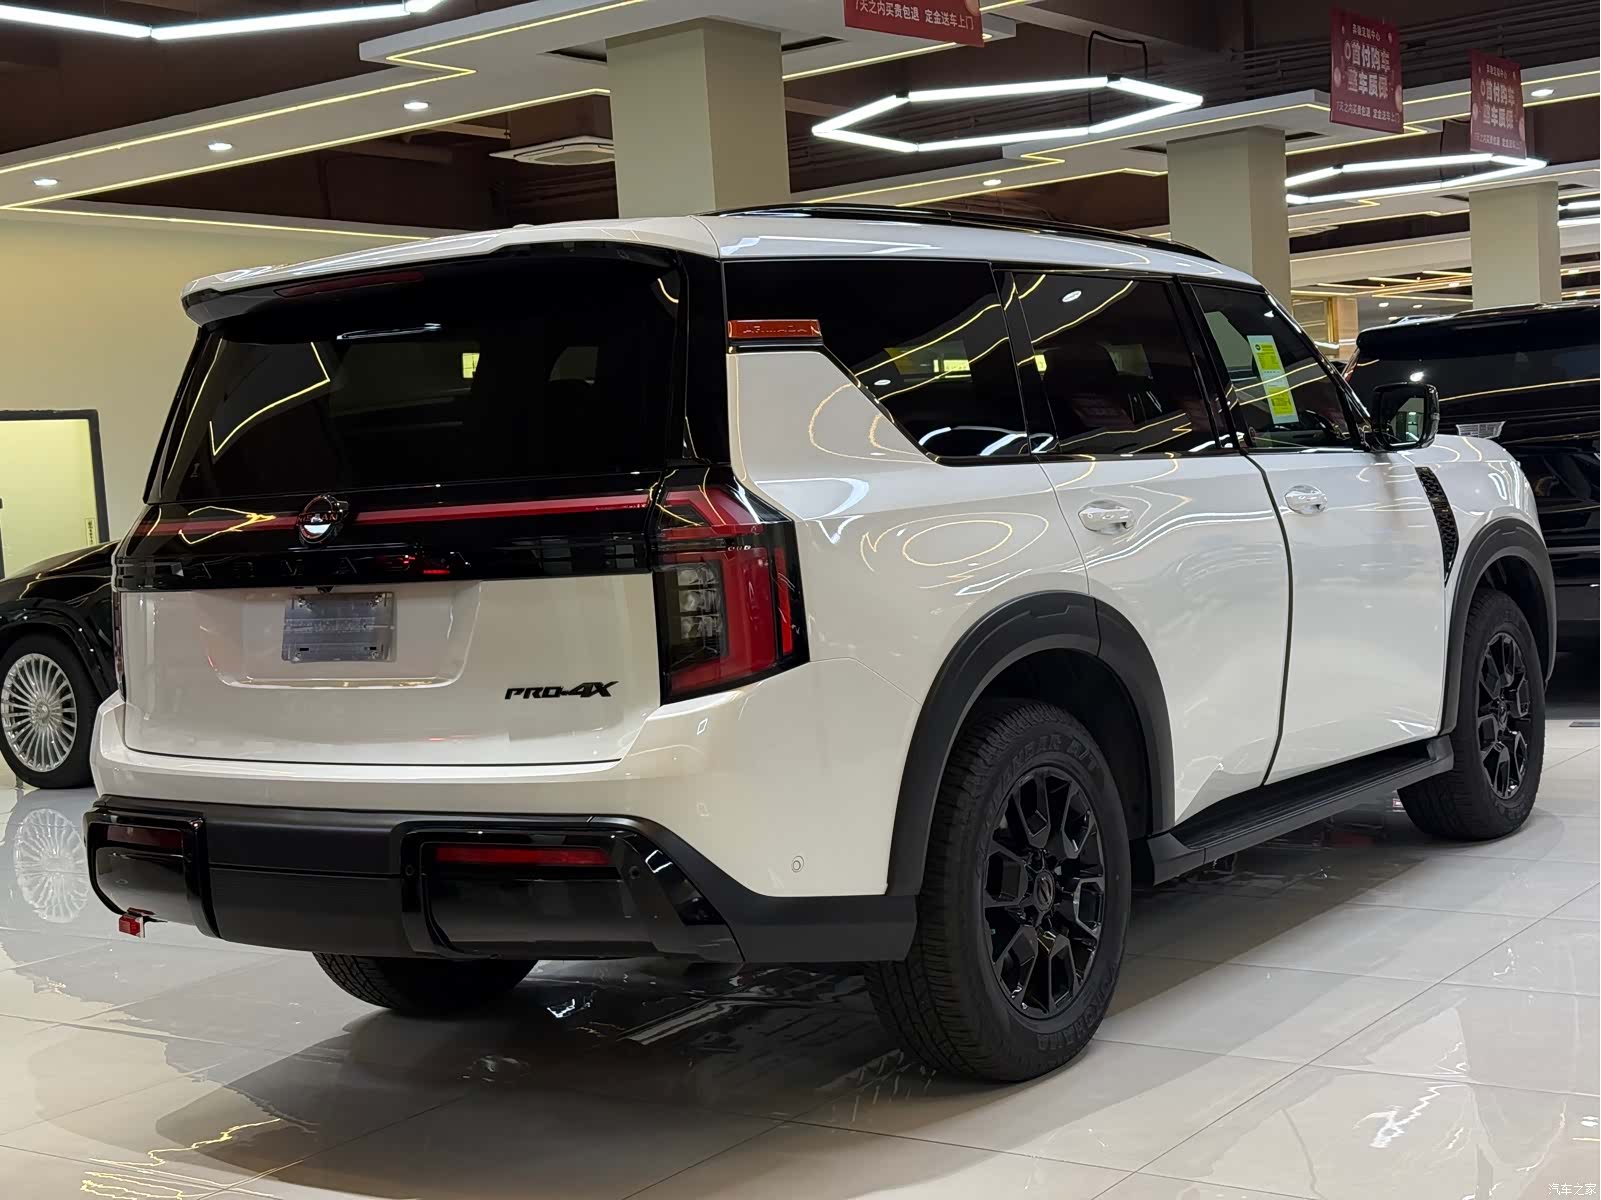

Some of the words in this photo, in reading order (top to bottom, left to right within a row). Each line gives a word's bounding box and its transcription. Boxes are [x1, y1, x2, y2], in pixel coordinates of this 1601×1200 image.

[925, 9, 975, 31] 定金送车上门
[1344, 40, 1391, 73] 0首付购车
[504, 680, 620, 700] PRO-4X
